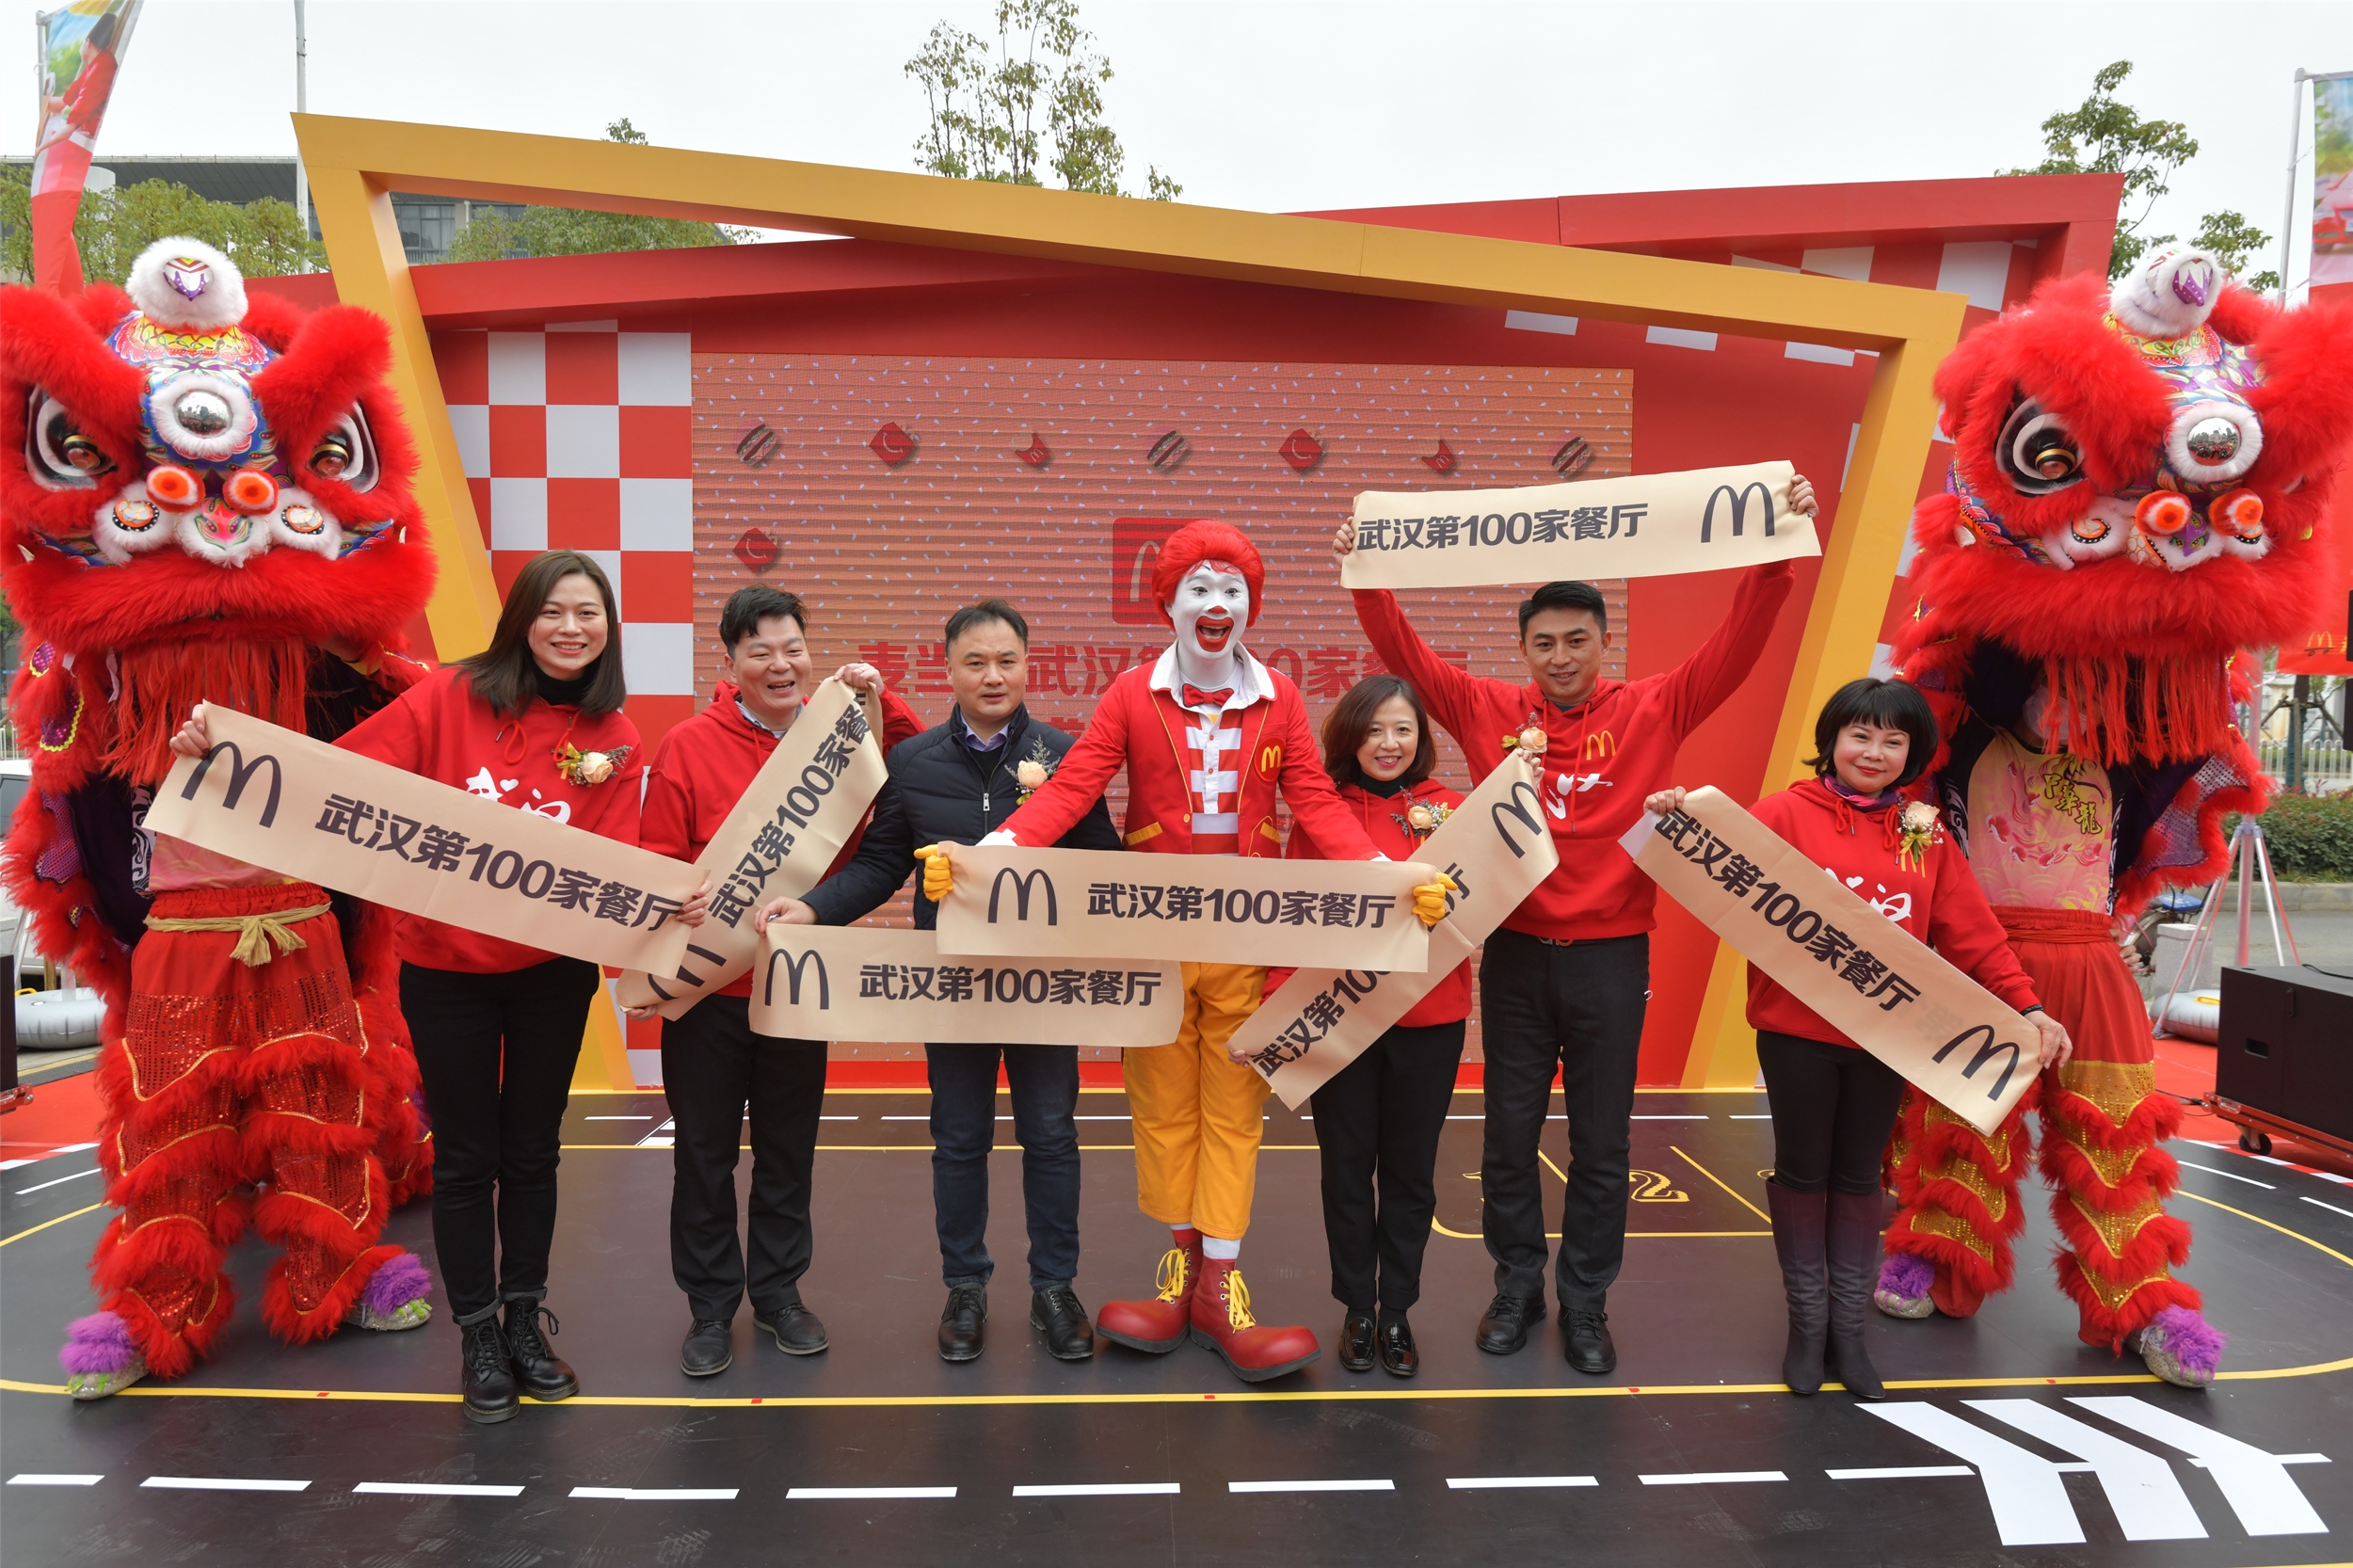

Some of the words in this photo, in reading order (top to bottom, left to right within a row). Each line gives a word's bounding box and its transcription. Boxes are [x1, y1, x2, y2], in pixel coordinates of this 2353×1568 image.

[1357, 504, 1647, 551] 武汉第100家餐厅
[708, 692, 871, 930] 武汉第100家餐
[315, 794, 685, 931] 武汉第100家餐厅
[1088, 883, 1397, 929] 武汉第100家餐厅
[1656, 807, 1922, 1011] 武汉第100家餐厅
[860, 965, 1162, 1007] 武汉第100家餐厅
